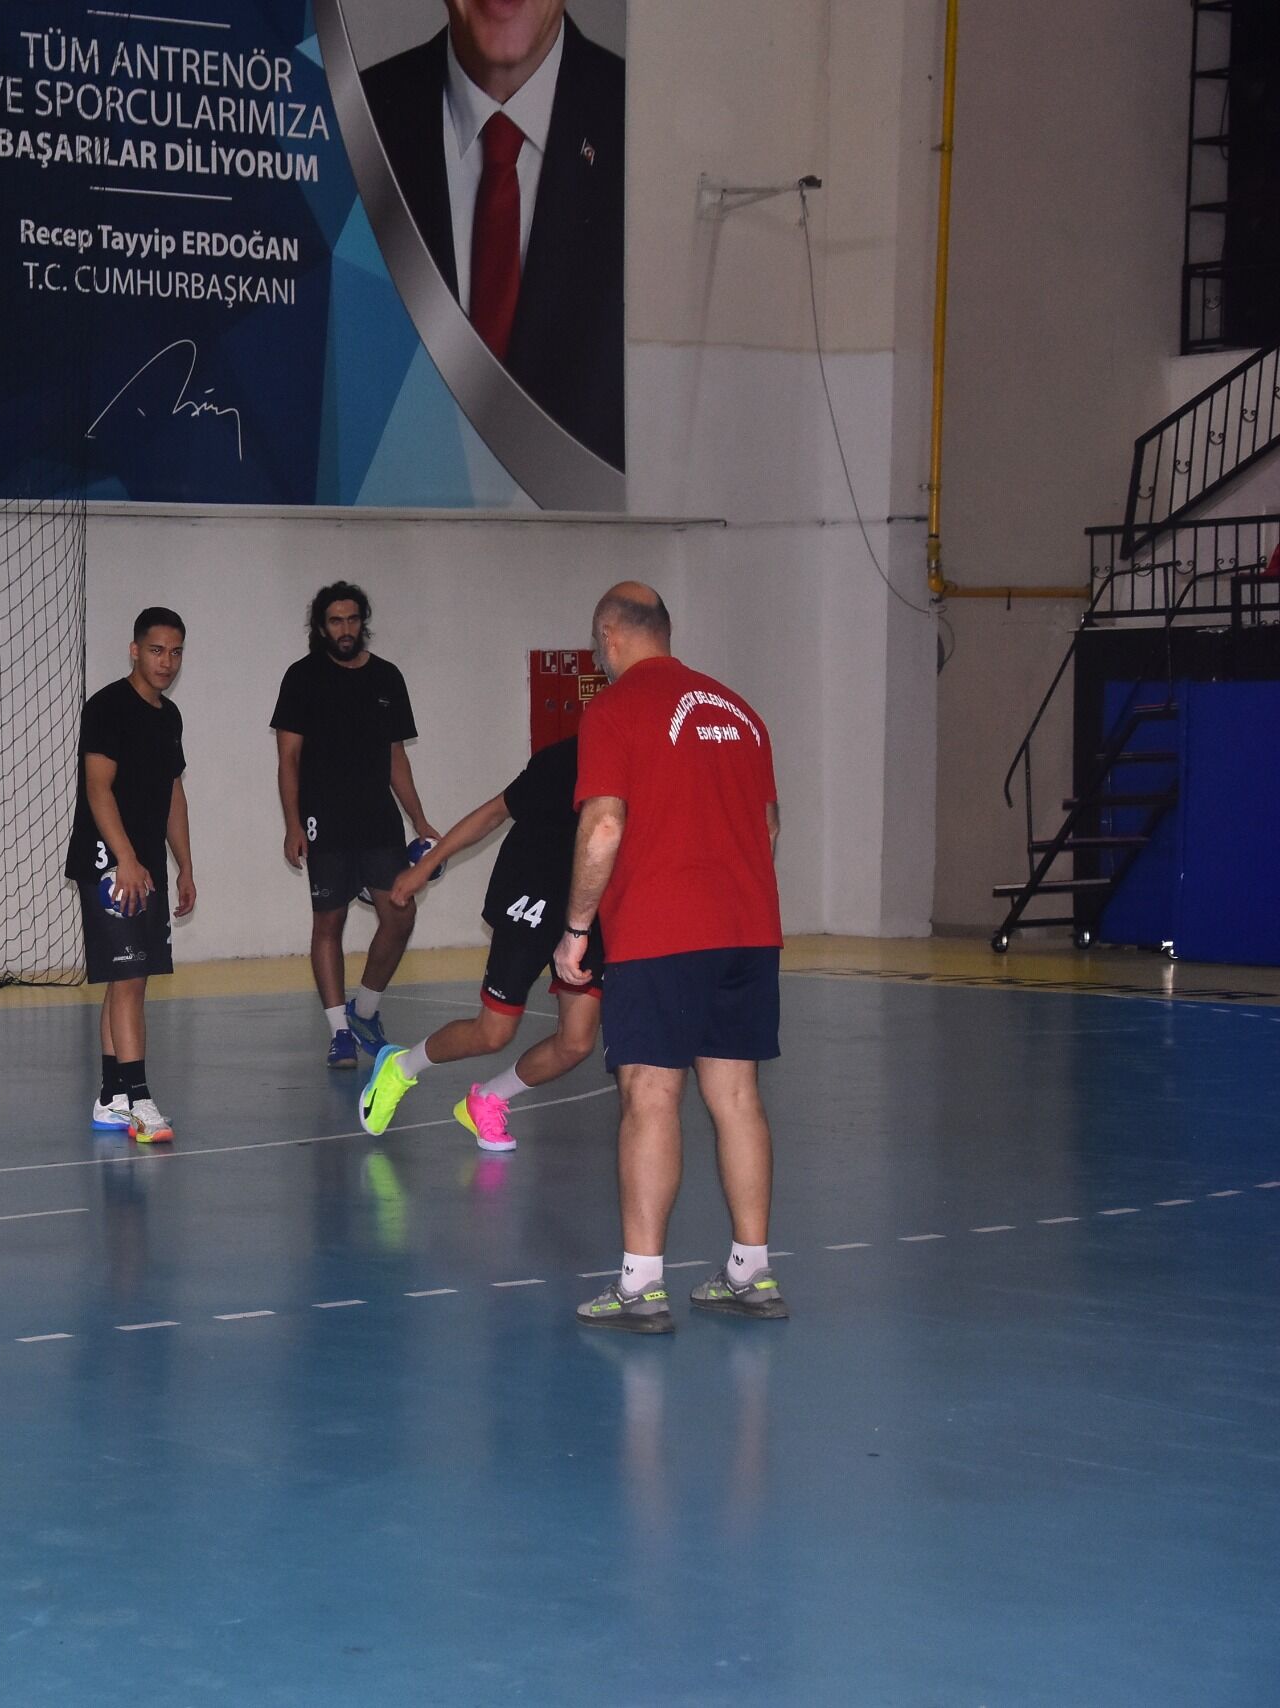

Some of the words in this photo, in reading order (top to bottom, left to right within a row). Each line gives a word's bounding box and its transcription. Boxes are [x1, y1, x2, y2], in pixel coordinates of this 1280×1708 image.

[20, 27, 100, 75] TÜM
[110, 41, 293, 94] ANTRENÖR
[35, 79, 330, 141] SPORCULARIMIZA
[165, 138, 319, 182] DİLİYORUM
[20, 219, 93, 254] Recep
[97, 224, 176, 259] Tayyip
[182, 230, 299, 261] ERDOĞAN
[23, 262, 68, 291] T.C.
[75, 265, 296, 309] CUMHURBAŞKANI
[581, 683, 594, 693] 112
[506, 895, 547, 929] 44
